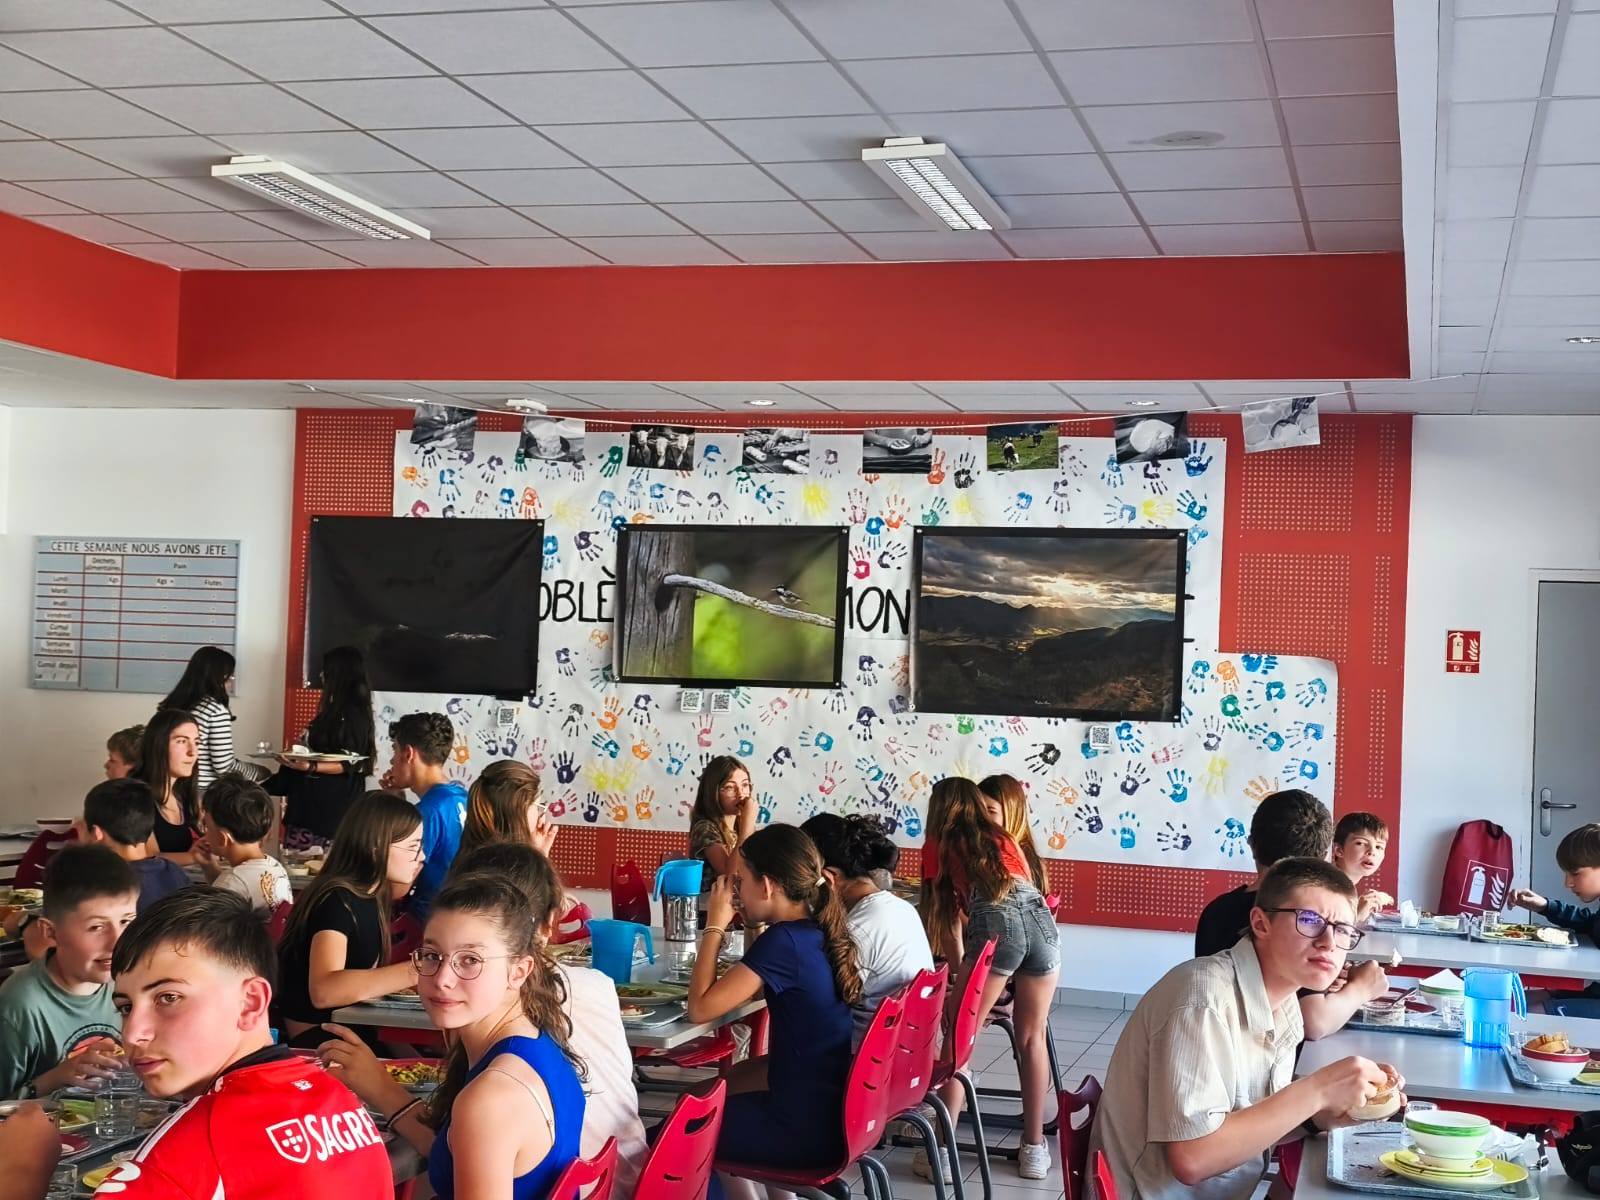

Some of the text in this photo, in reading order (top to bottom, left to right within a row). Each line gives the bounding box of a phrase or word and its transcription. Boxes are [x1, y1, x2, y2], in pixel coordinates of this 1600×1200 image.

[51, 541, 80, 552] CETTE
[84, 542, 128, 553] SEMAINE
[132, 544, 161, 554] NOUS
[164, 544, 200, 554] AVONS
